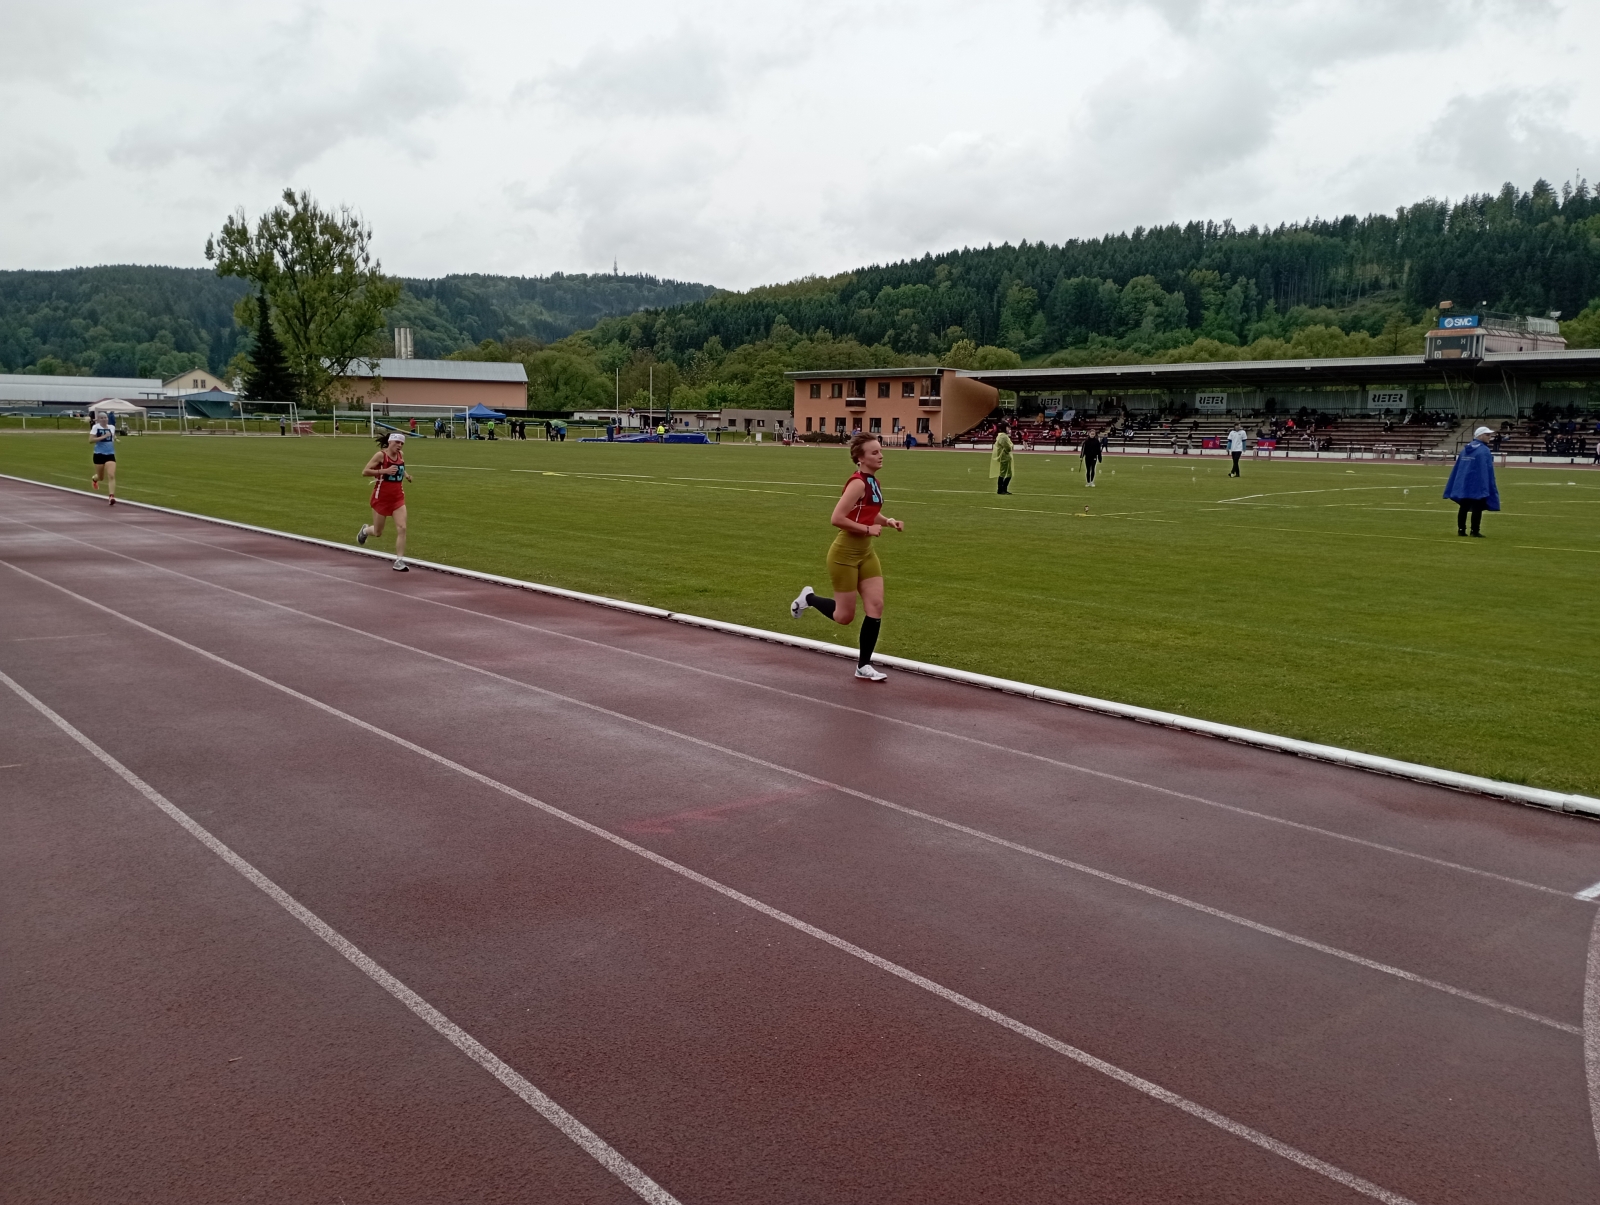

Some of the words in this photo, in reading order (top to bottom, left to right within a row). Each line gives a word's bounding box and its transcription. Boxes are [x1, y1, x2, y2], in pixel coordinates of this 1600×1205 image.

[1454, 317, 1472, 326] SMC
[1199, 396, 1224, 404] RIETER
[1372, 393, 1403, 402] RIETER
